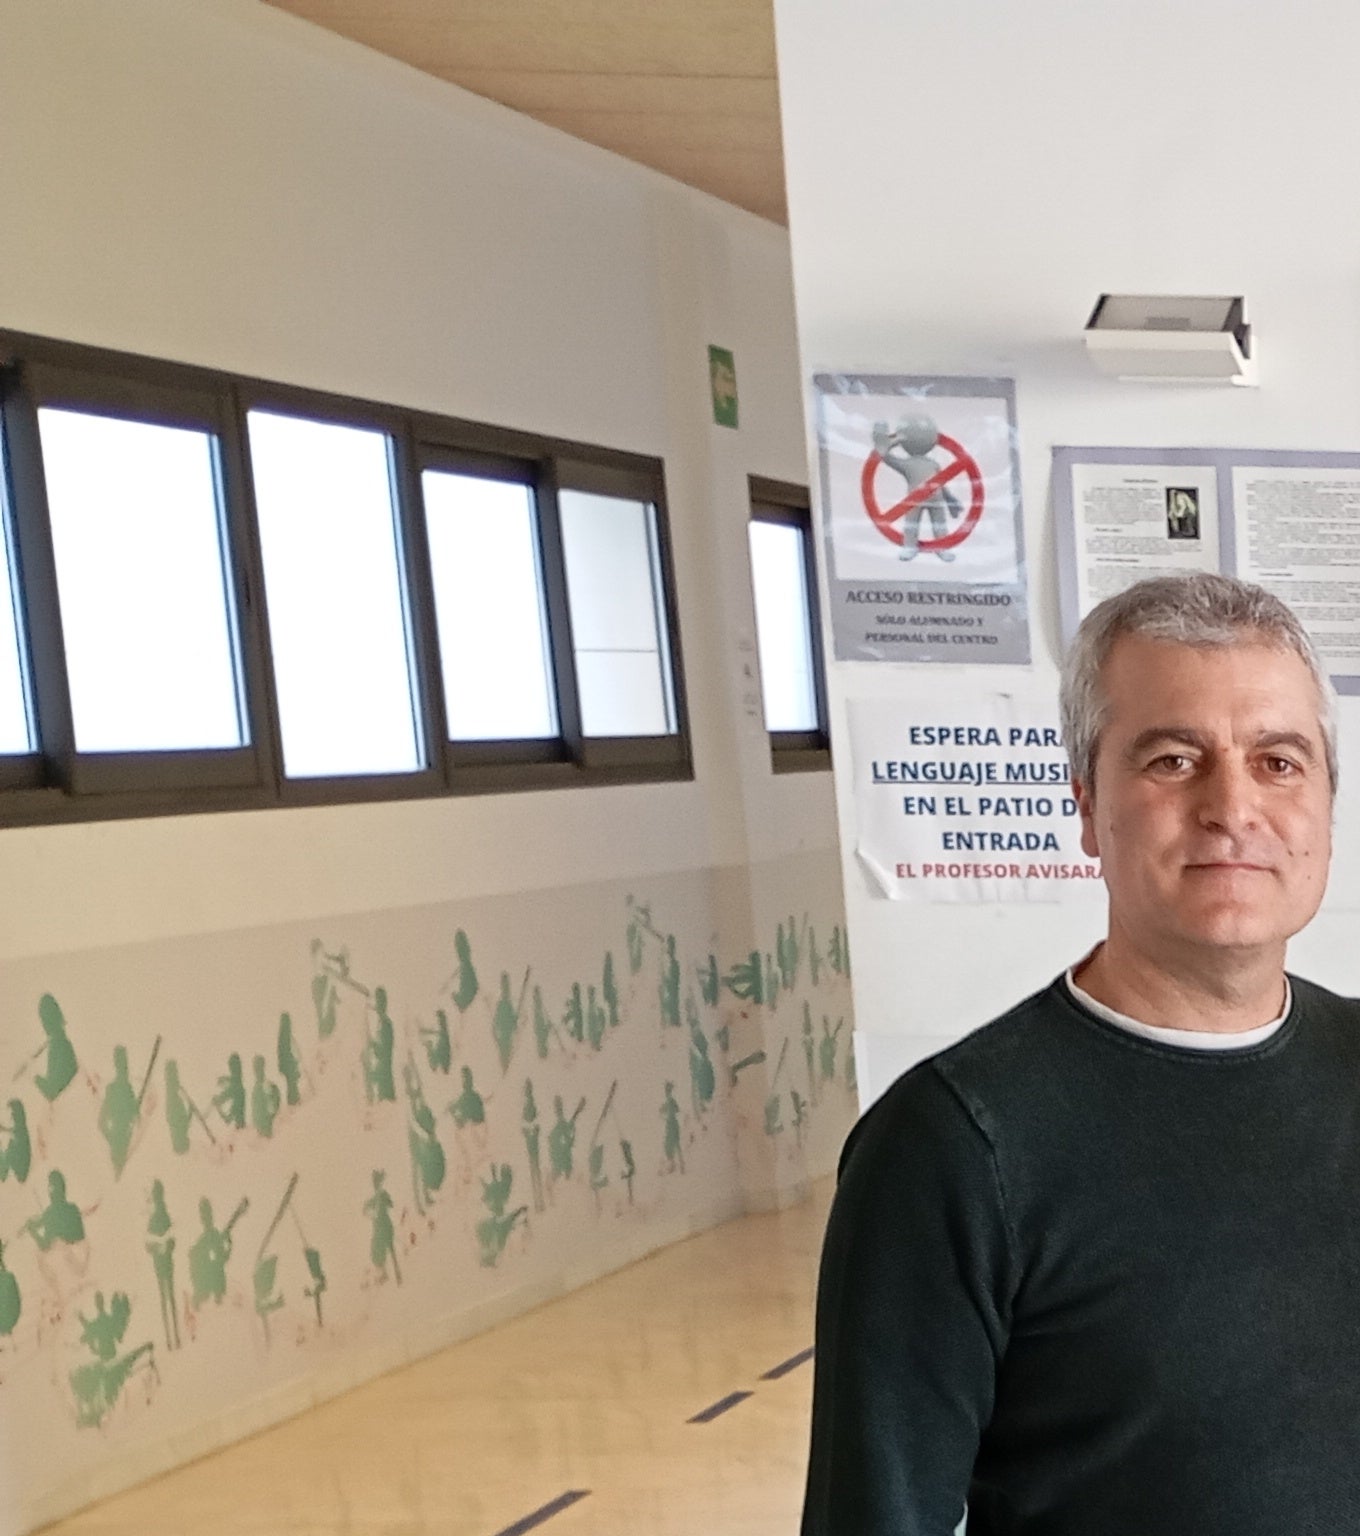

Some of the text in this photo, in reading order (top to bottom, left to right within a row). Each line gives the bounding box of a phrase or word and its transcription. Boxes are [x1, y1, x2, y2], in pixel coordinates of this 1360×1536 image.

[846, 590, 1012, 607] ACCESO RESTRINGIDO
[909, 615, 974, 627] ALUMNADO
[865, 632, 998, 645] PERSONAL DEL CENTRO
[909, 726, 1062, 747] ESPERA PAR
[872, 761, 1068, 786] LENGUAJE MUSI
[904, 797, 1077, 817] EN EL PATIO D
[942, 832, 1060, 851] ENTRADA
[896, 863, 916, 878] EL
[923, 863, 1021, 879] PROFESOR
